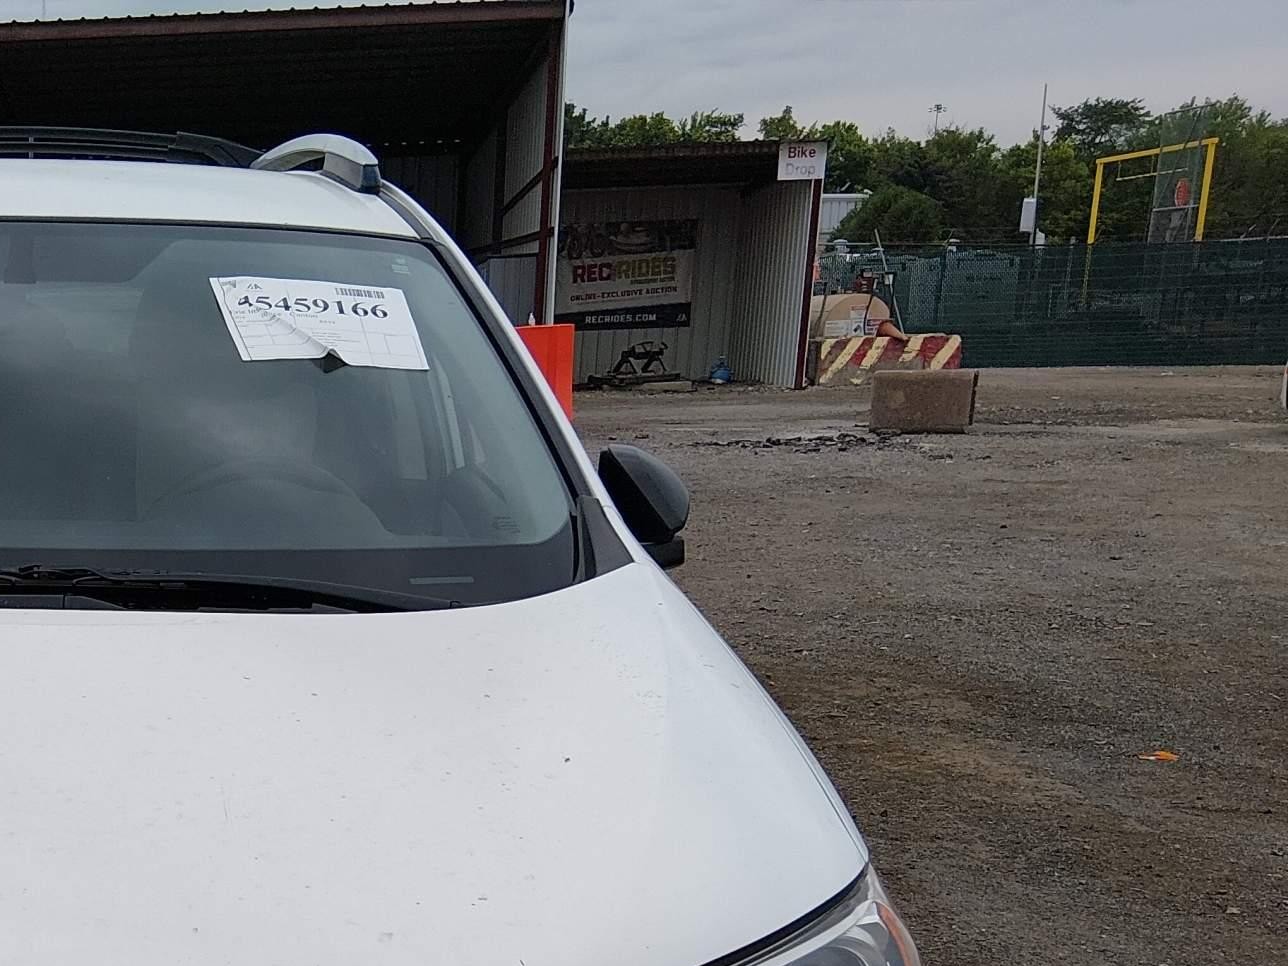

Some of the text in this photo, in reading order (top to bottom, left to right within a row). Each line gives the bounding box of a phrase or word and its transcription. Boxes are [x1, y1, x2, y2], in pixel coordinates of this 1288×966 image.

[788, 146, 816, 158] Bike
[785, 163, 815, 177] Drop
[646, 286, 678, 295] AUCTION
[237, 295, 389, 319] 45459166
[585, 313, 657, 324] RECRIDES.COM
